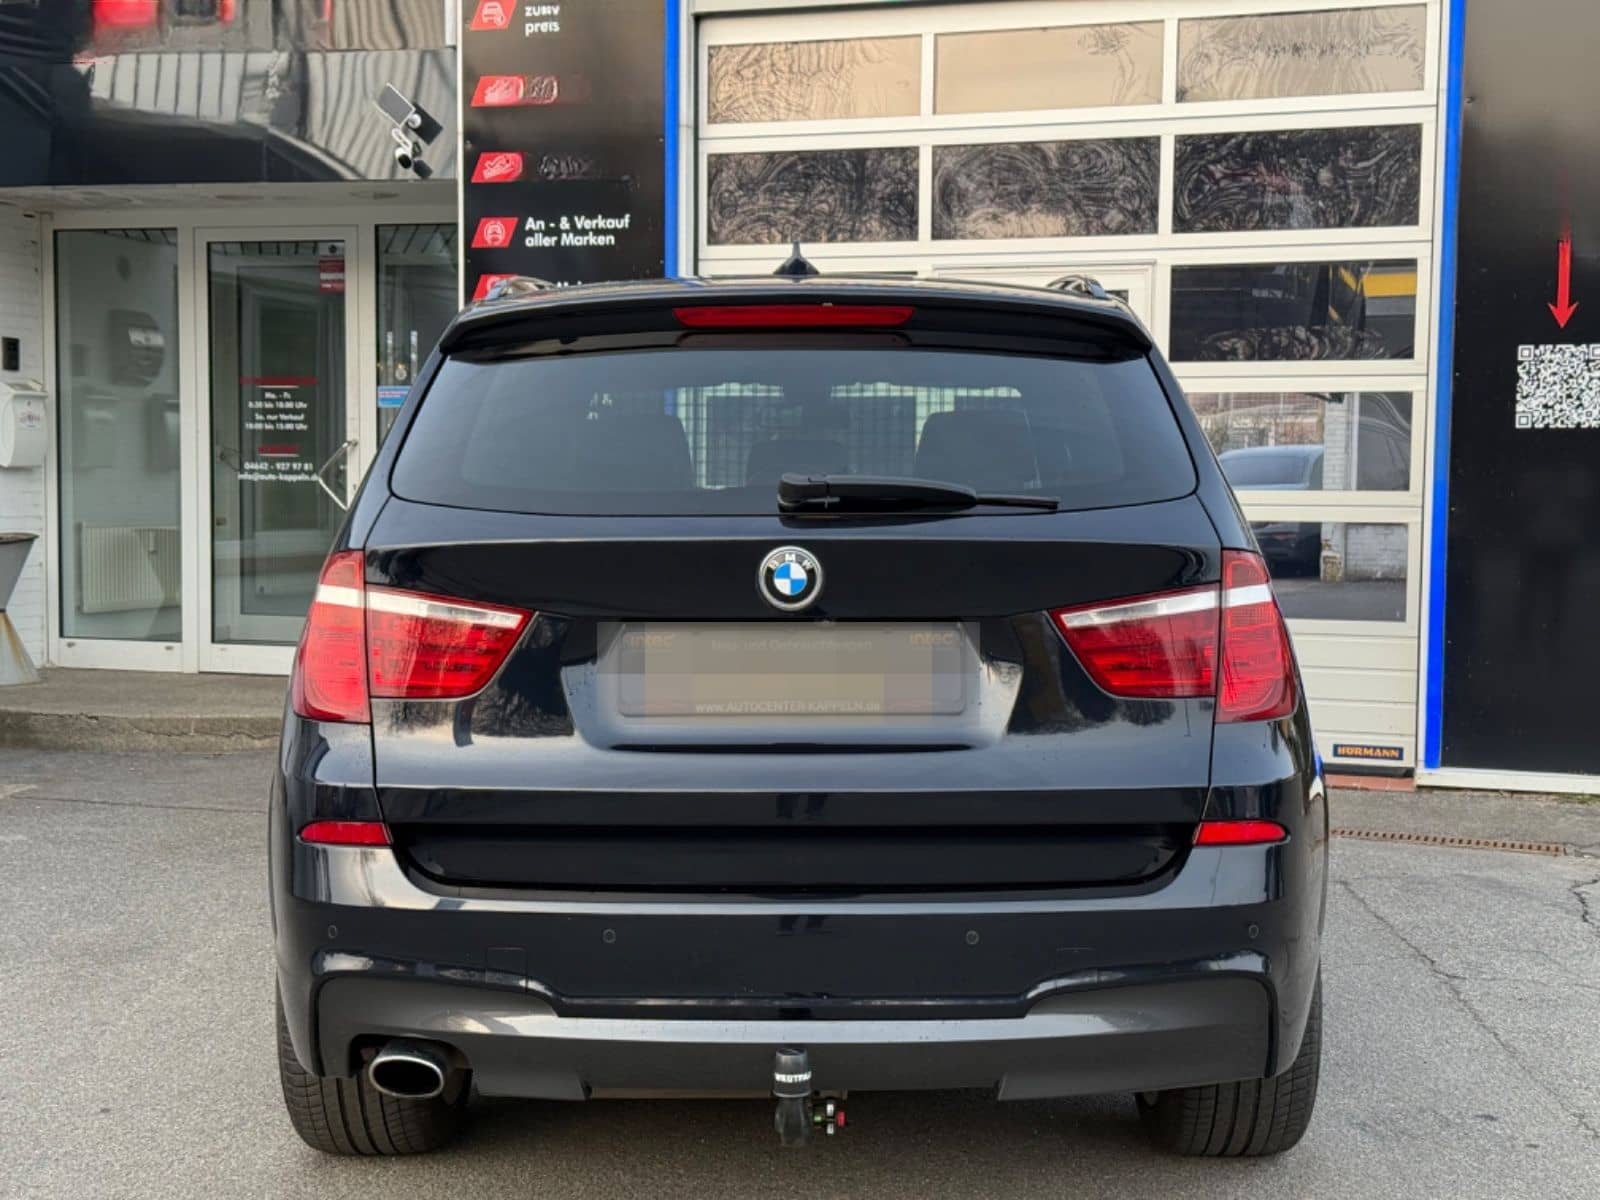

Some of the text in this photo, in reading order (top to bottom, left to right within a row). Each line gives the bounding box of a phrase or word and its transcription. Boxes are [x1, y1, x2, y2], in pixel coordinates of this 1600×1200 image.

[525, 216, 545, 231] An
[559, 216, 570, 230] &
[574, 213, 631, 229] Verkauf
[525, 231, 615, 247] aller Marken
